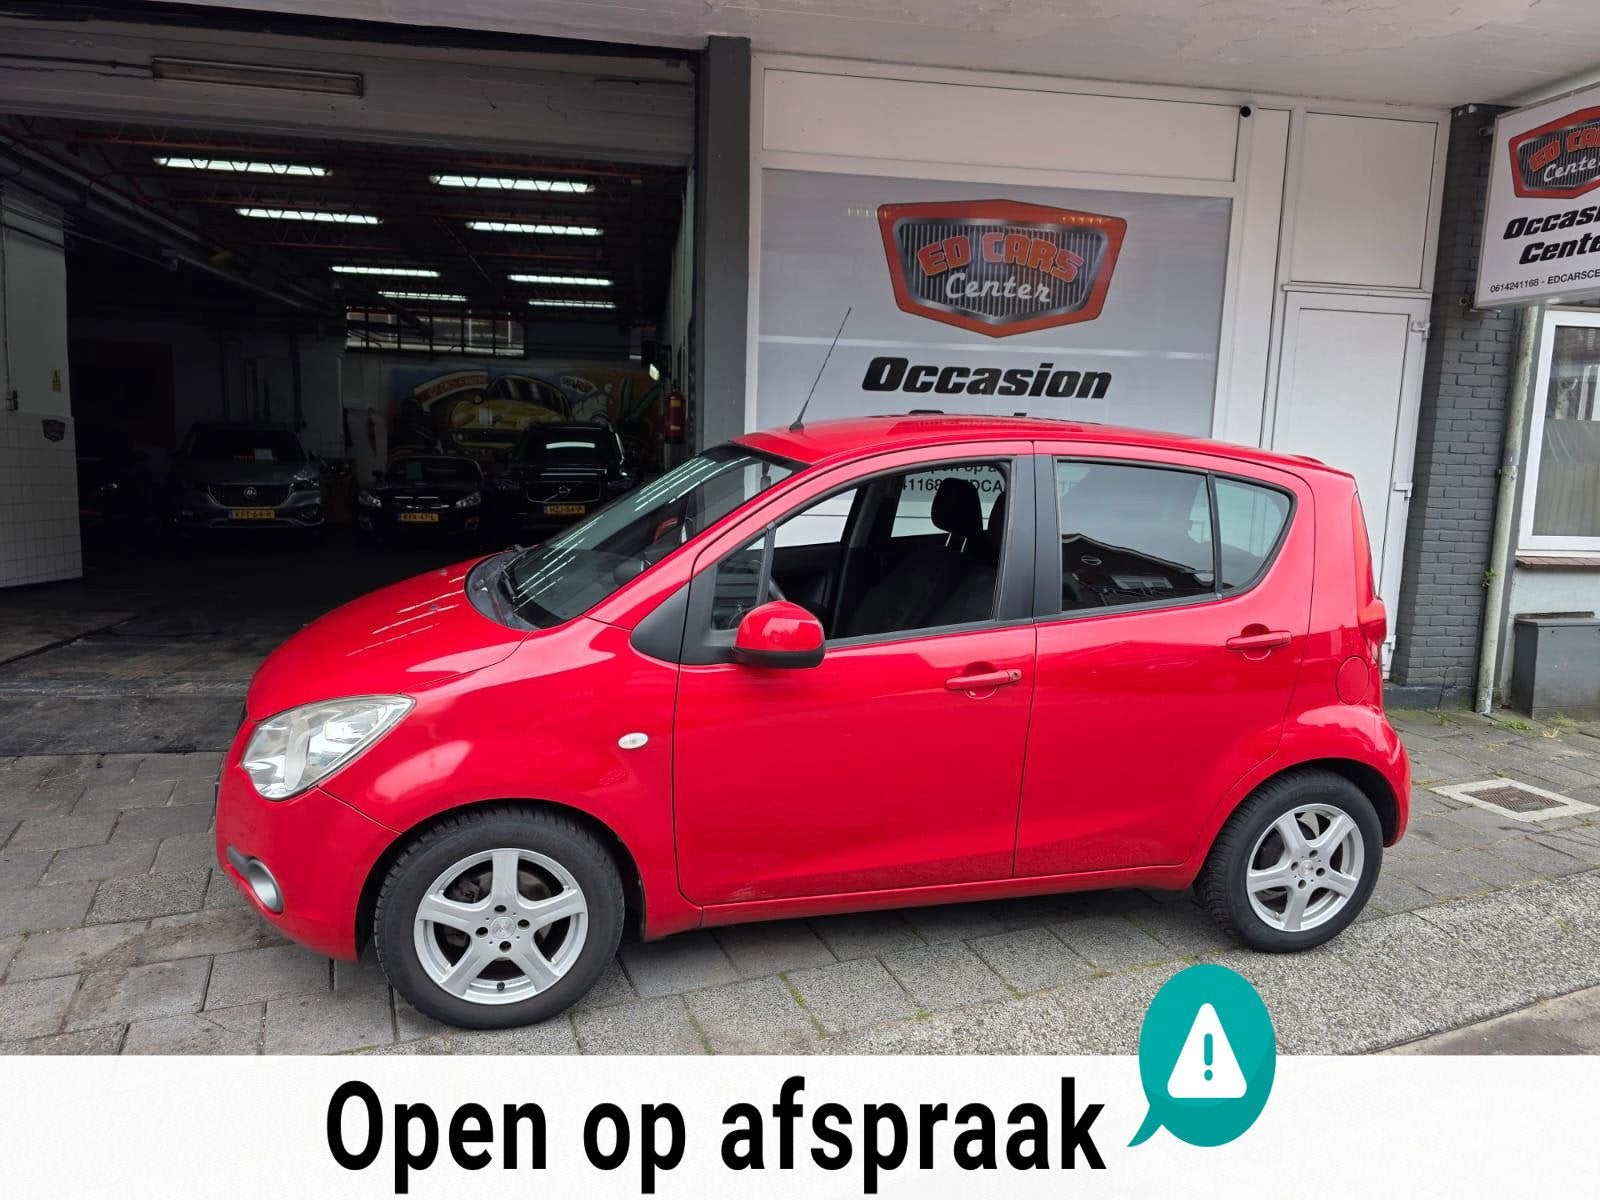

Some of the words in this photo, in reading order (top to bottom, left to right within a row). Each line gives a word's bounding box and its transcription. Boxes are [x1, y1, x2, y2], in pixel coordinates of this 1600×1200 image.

[1529, 141, 1561, 172] ED
[1567, 127, 1600, 153] CA
[1544, 156, 1600, 182] Cente
[917, 235, 972, 277] ED
[982, 232, 1084, 283] CARS
[946, 272, 1050, 302] Center
[1490, 279, 1540, 293] 0614241168
[862, 356, 1112, 399] Occasion
